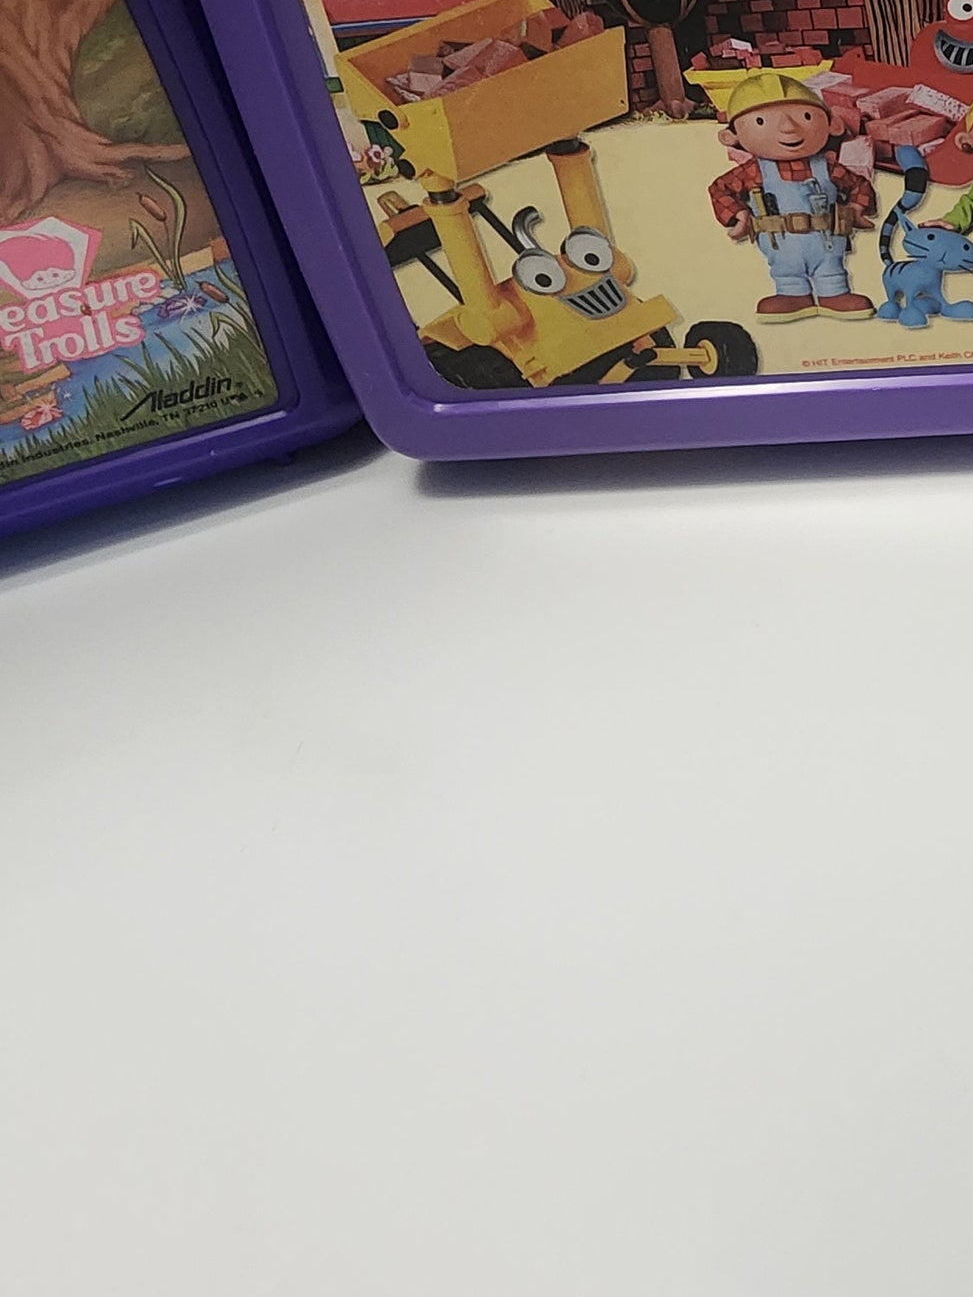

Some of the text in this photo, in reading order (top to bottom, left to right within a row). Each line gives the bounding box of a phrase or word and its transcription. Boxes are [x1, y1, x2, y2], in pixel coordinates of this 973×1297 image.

[5, 313, 141, 370] Trolls
[897, 354, 917, 362] PLC
[919, 353, 936, 361] and
[939, 351, 961, 359] Keith
[120, 376, 232, 421] Aladdin
